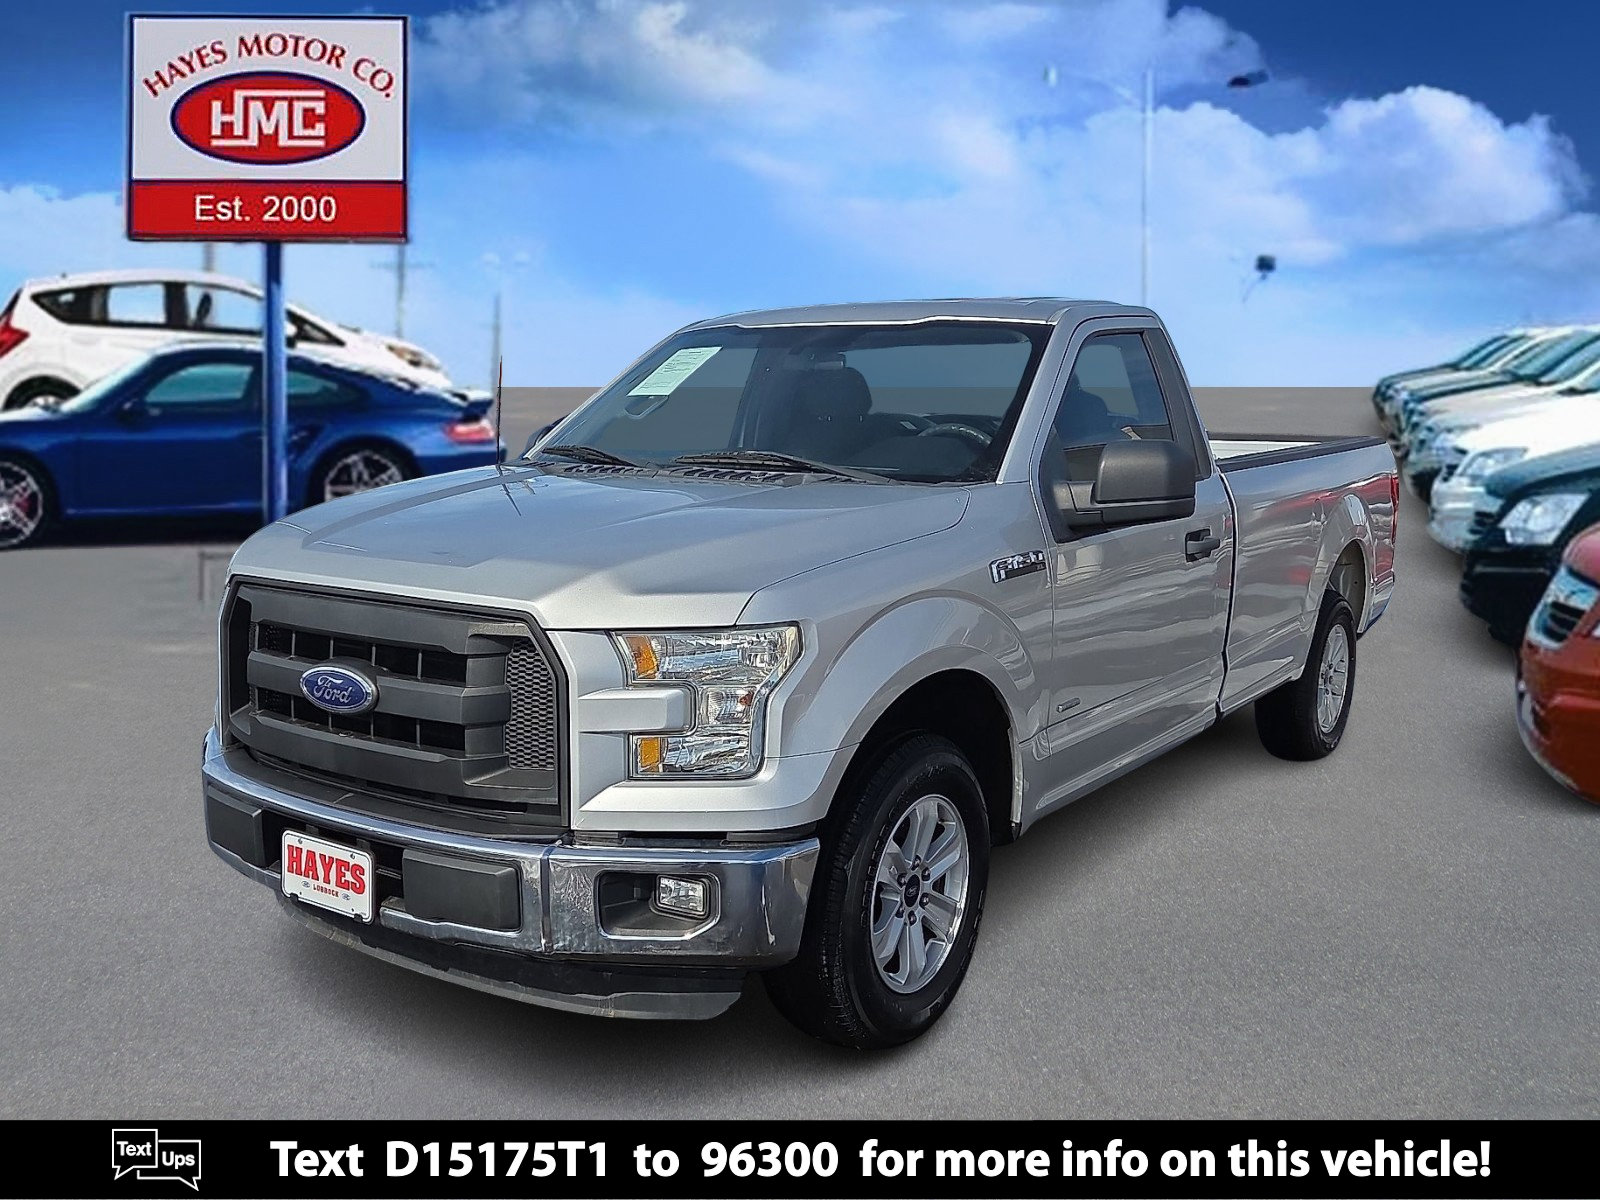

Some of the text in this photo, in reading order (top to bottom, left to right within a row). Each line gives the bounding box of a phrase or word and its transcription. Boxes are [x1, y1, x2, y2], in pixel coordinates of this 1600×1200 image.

[143, 33, 395, 99] HAYES MOTOR CO.
[210, 88, 326, 147] HMC
[194, 194, 337, 222] Est. 2000
[313, 675, 353, 703] Ford
[287, 844, 366, 895] HAYES
